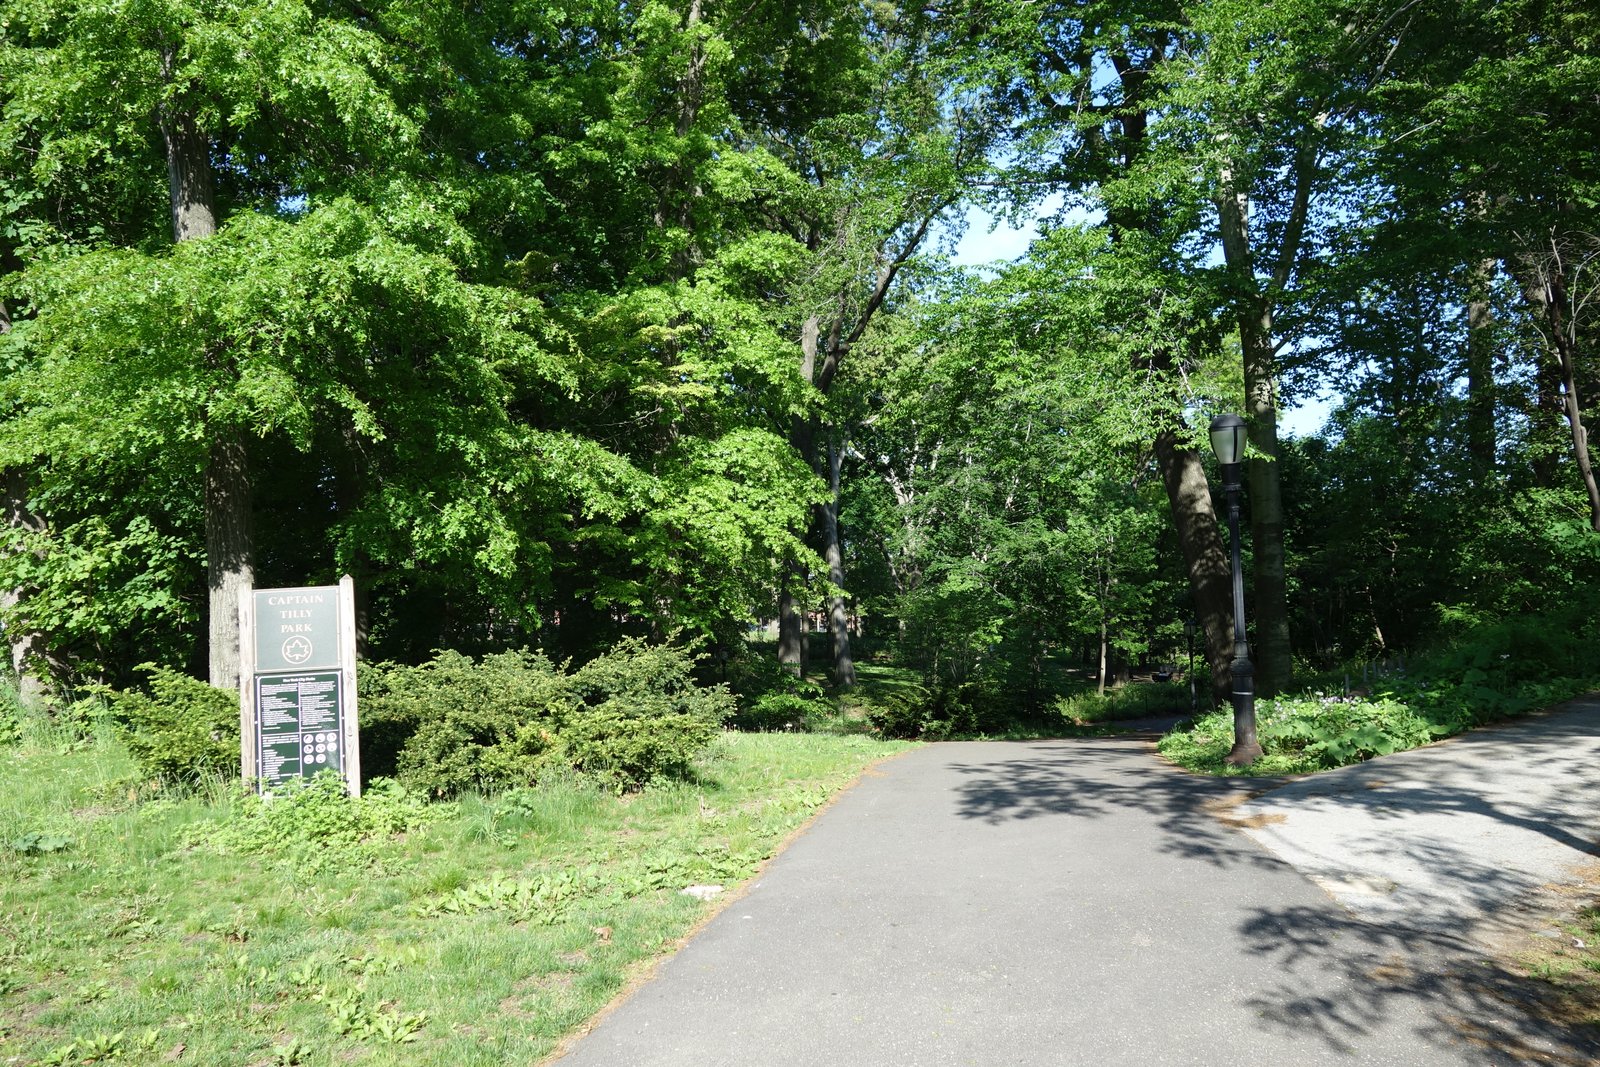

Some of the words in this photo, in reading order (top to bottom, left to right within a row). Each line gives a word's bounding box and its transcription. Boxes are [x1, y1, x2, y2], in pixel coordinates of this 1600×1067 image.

[268, 595, 323, 605] CAPTAIN
[280, 609, 312, 619] TILLY
[281, 623, 312, 633] PARK
